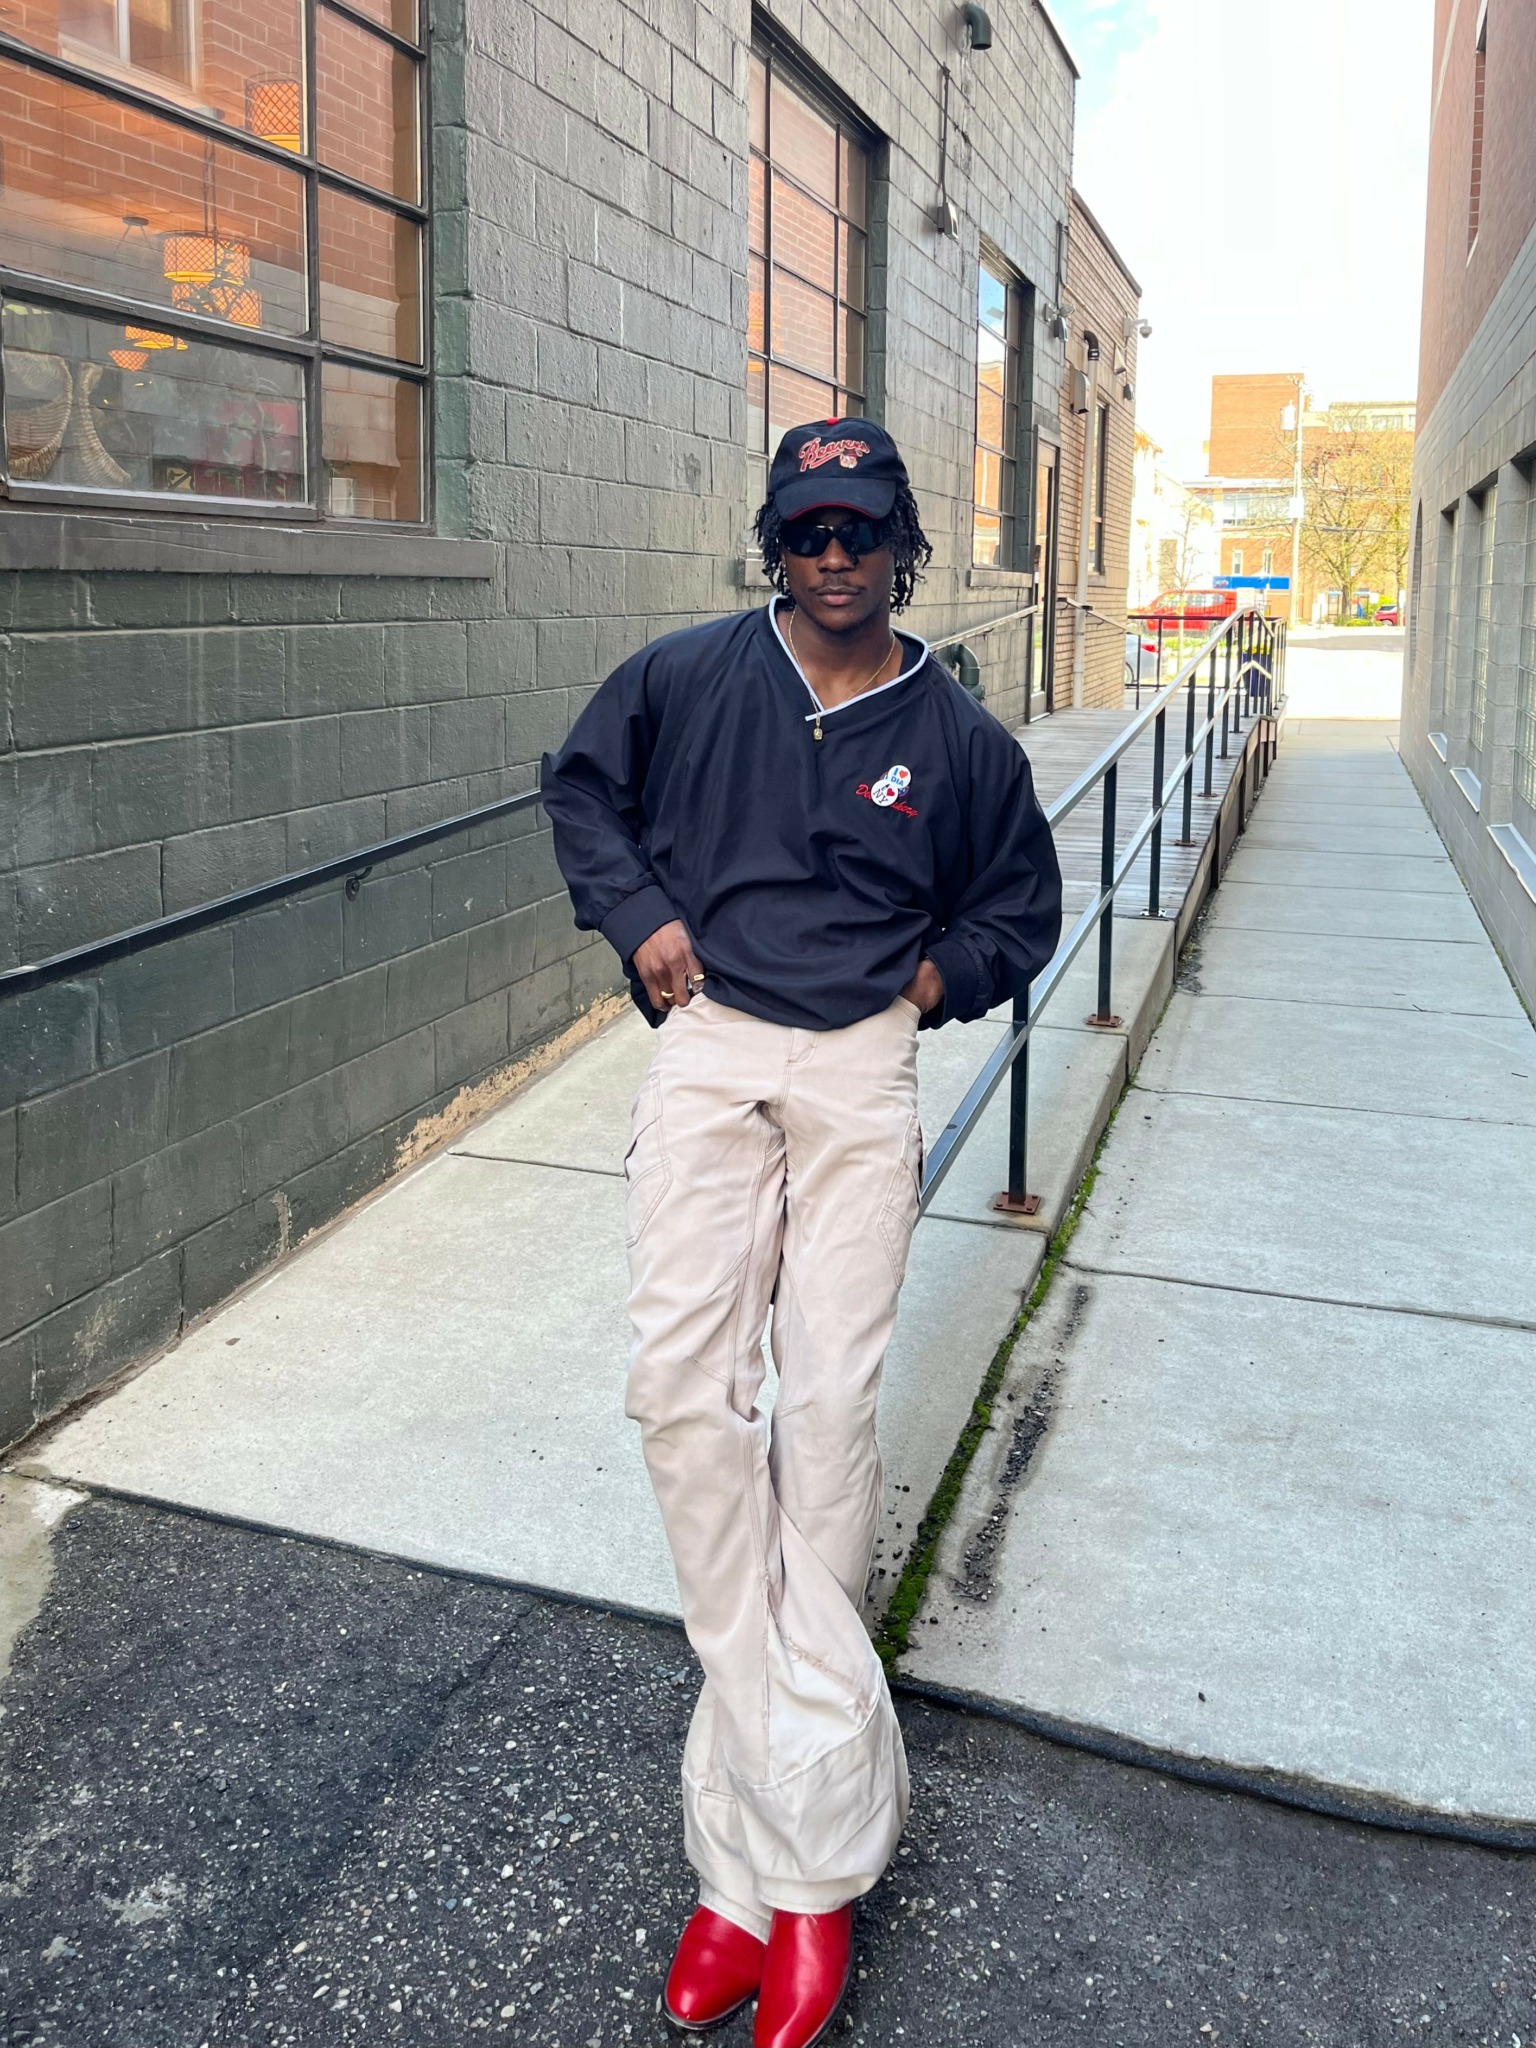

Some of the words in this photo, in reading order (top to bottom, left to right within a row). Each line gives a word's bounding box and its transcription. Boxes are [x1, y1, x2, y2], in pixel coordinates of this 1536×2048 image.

[799, 437, 870, 472] Beavers
[893, 767, 899, 776] I
[890, 776, 904, 786] DIA
[873, 789, 888, 804] NY
